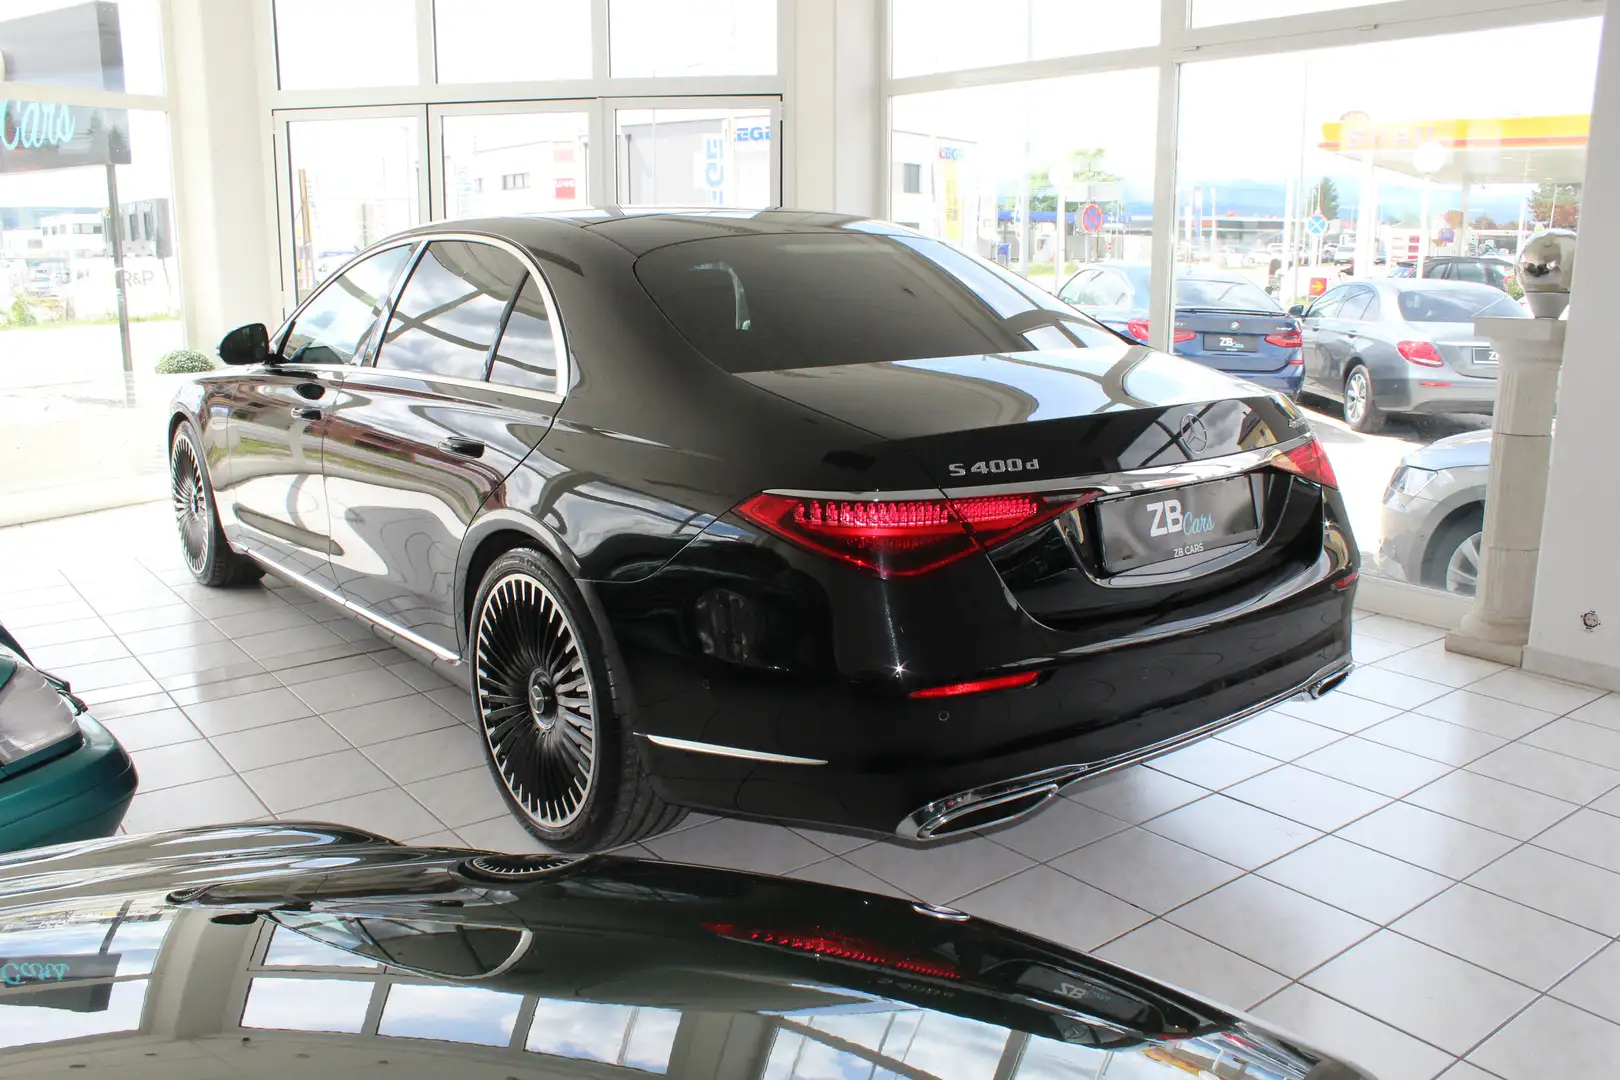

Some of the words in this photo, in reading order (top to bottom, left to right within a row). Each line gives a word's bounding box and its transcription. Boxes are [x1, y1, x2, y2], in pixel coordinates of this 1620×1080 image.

[0, 99, 76, 150] Cars
[1146, 499, 1184, 537] ZB
[1183, 511, 1215, 536] Cars
[1173, 547, 1184, 558] ZB
[1184, 543, 1204, 555] CARS
